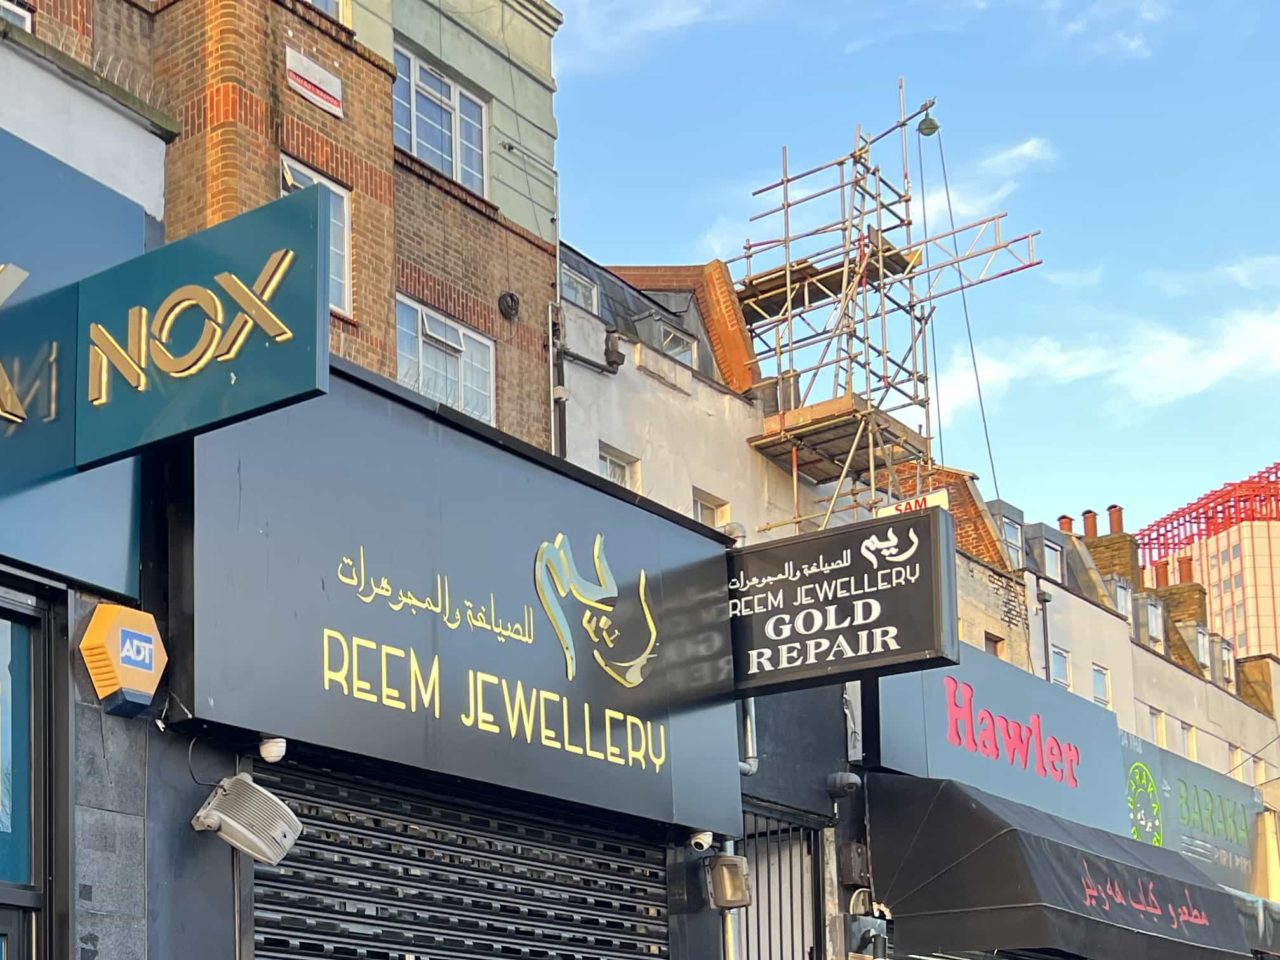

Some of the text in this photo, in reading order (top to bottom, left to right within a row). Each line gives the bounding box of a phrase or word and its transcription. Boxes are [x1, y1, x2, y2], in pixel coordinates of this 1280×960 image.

[89, 249, 295, 405] NOX
[729, 563, 920, 617] REEM JEWELLERY
[464, 592, 534, 644] للصياغة
[765, 599, 881, 640] GOLD
[120, 638, 153, 664] ADT
[747, 627, 901, 674] REPAIR
[323, 628, 666, 773] REEM JEWELLERY
[944, 675, 1079, 788] Hawler
[1177, 778, 1249, 847] BARAKA
